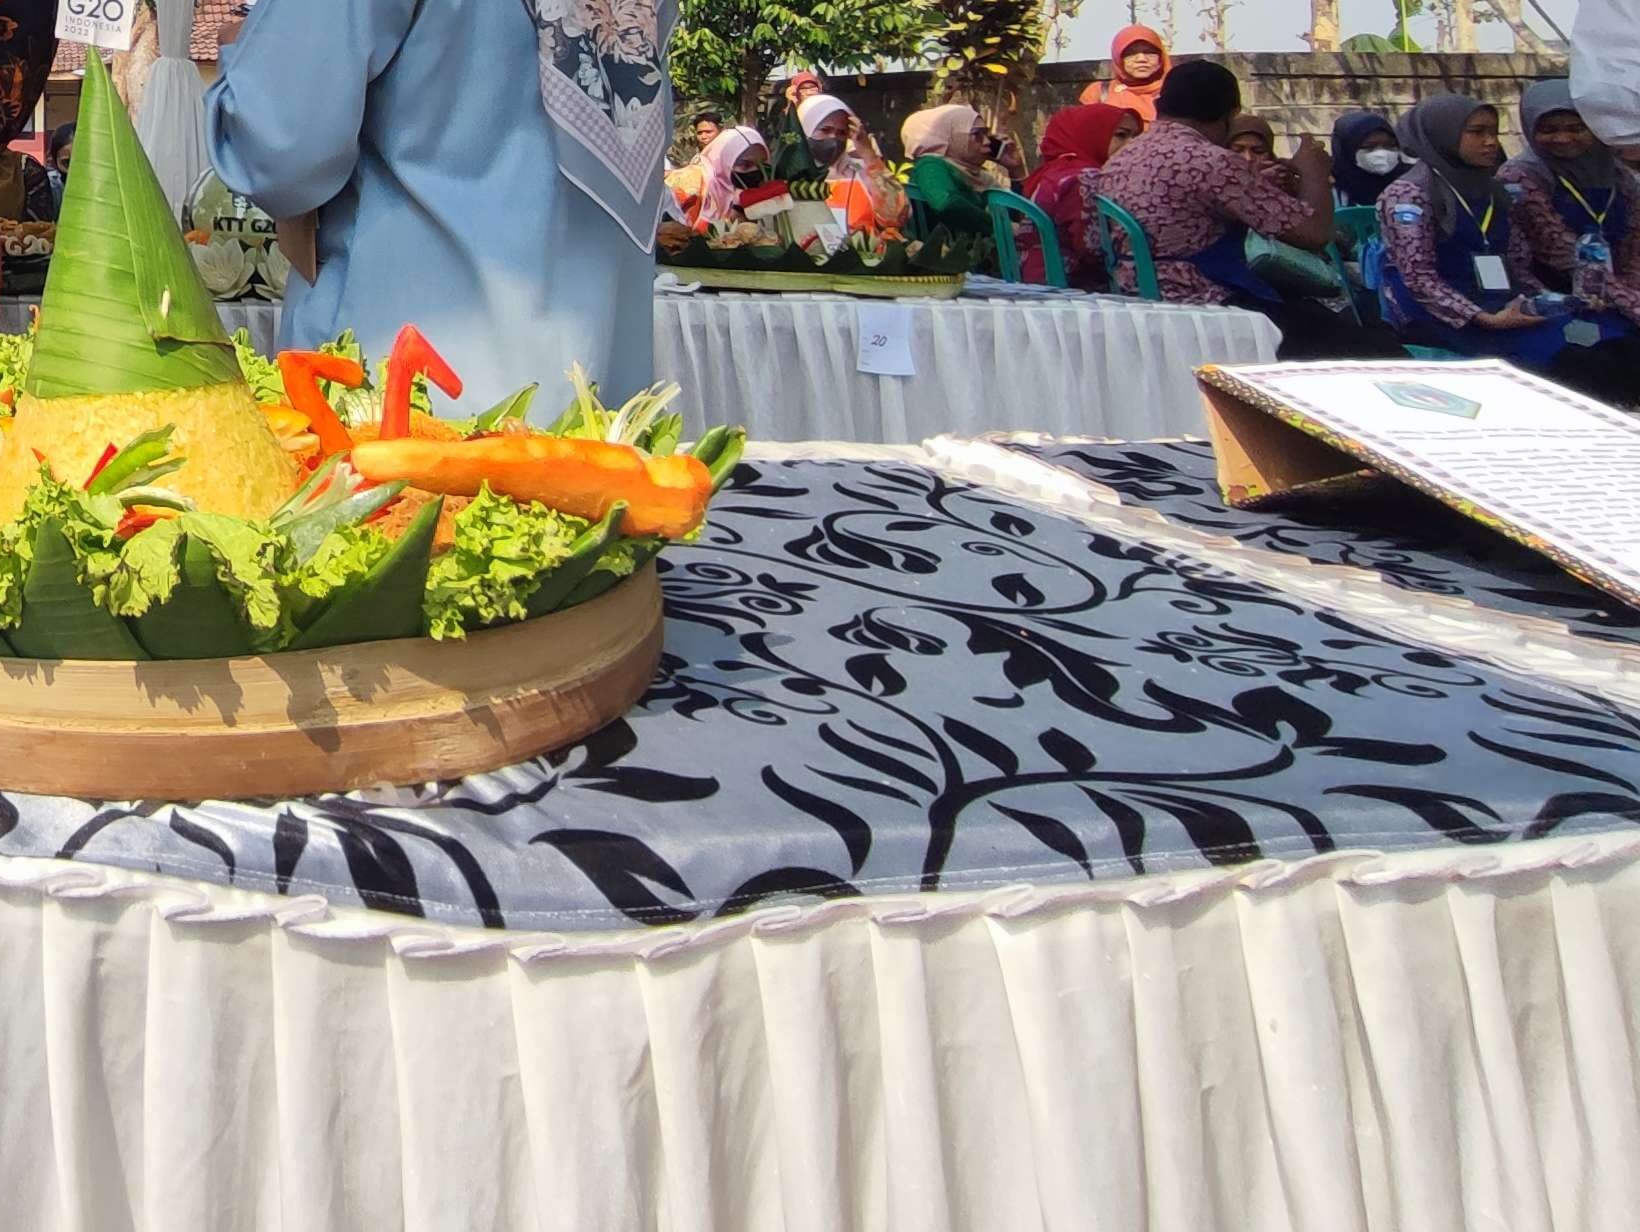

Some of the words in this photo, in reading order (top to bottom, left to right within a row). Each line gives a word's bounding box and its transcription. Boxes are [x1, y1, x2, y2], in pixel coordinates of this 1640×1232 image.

[64, 25, 89, 36] 2022
[65, 15, 122, 33] INDONESIA
[213, 215, 247, 233] KTT
[871, 334, 888, 347] 20
